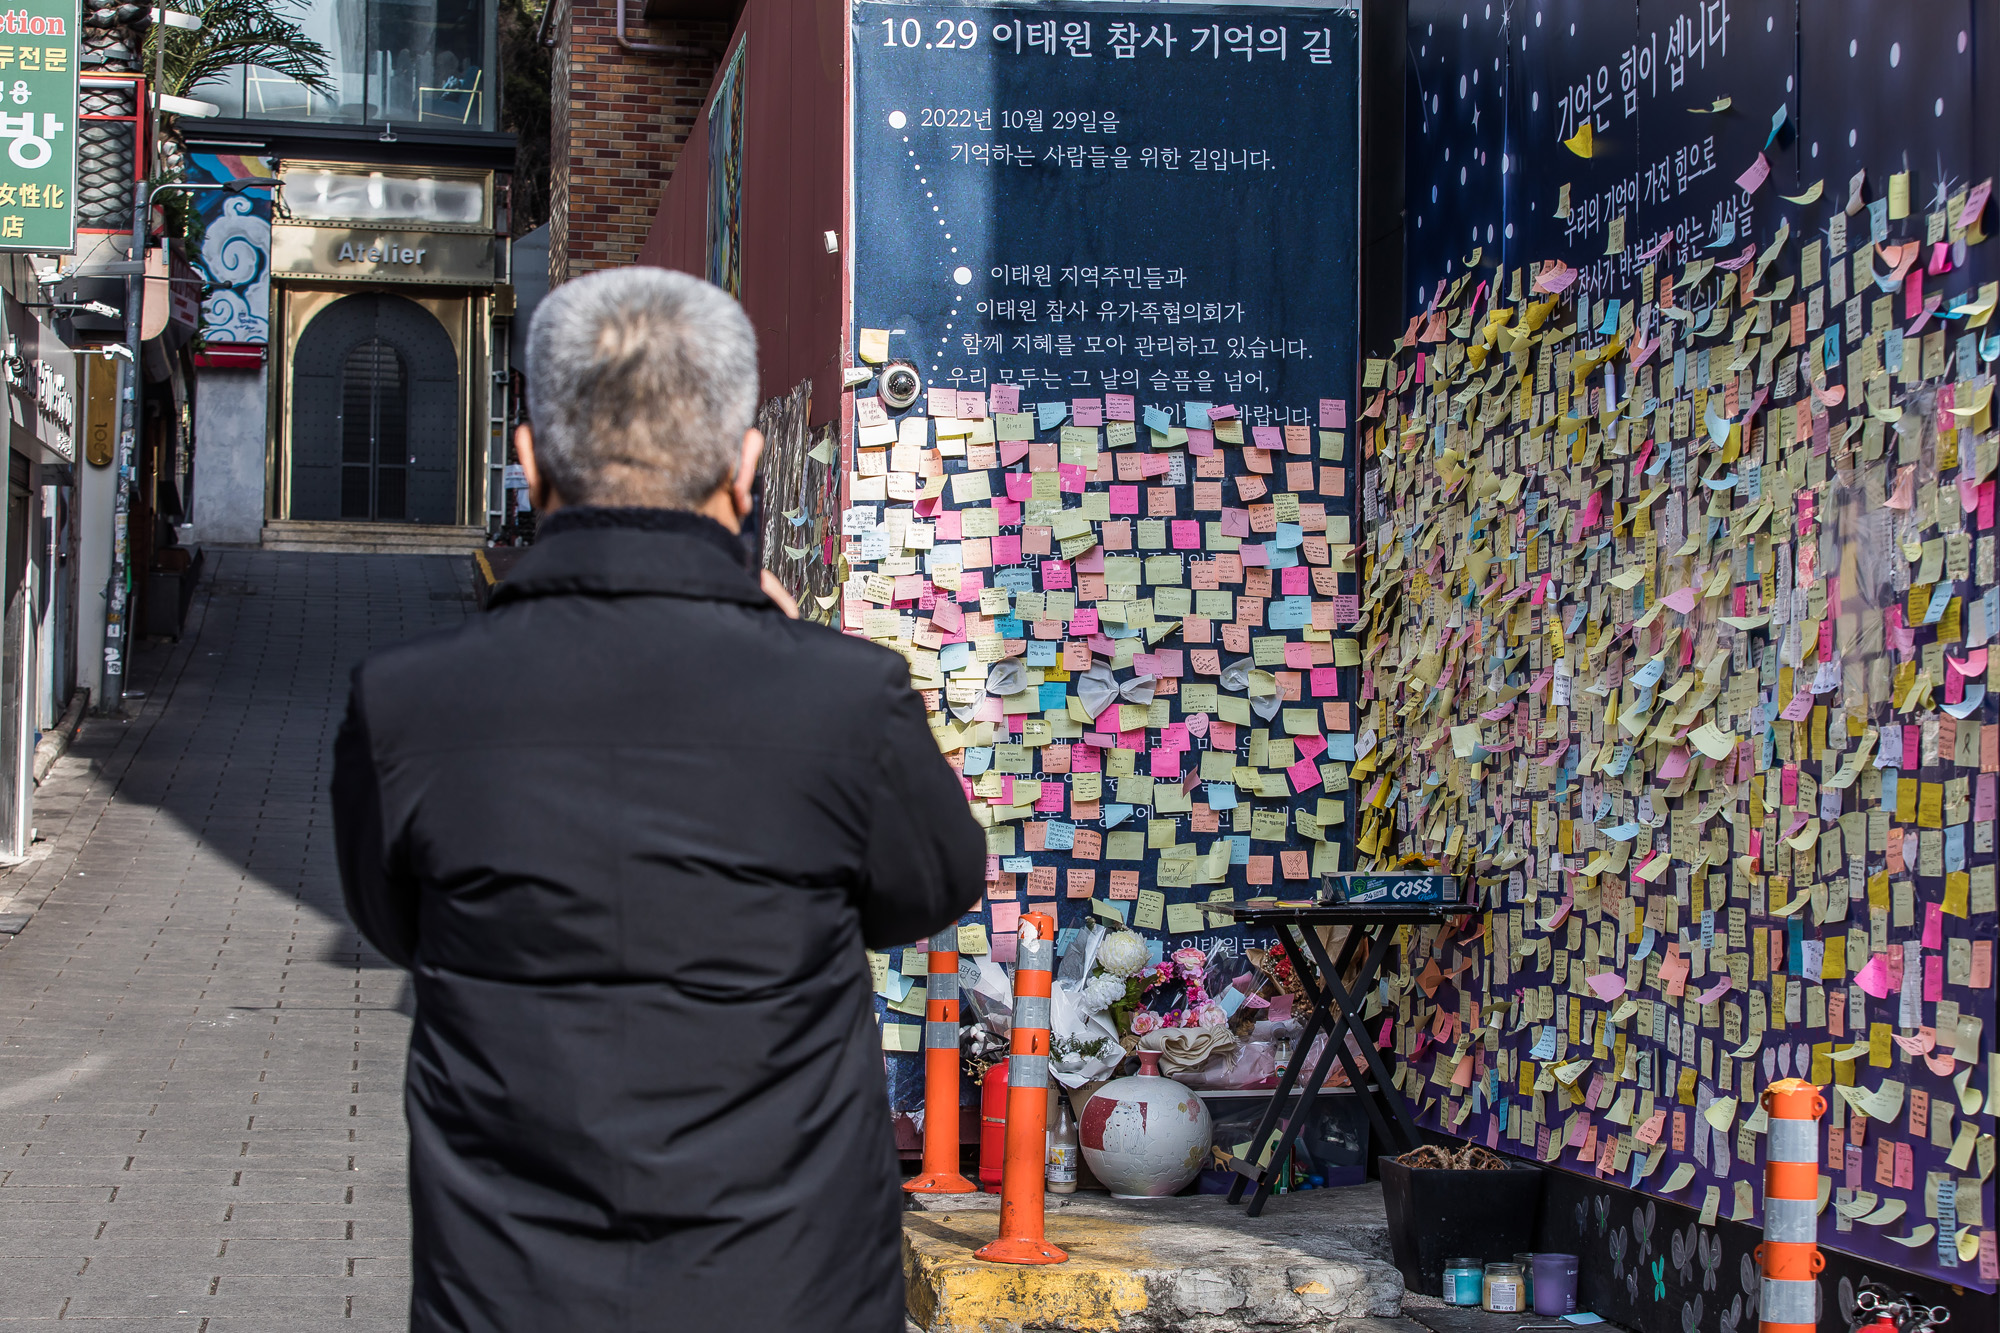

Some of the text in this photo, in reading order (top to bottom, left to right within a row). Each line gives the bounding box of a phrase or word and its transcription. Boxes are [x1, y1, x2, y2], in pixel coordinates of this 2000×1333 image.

[881, 18, 1333, 64] 10.29 이태원 참사 기억의 길
[1619, 32, 1656, 118] 힘이
[1664, 0, 1730, 92] 셉니다
[920, 108, 1120, 134] 2022년 10월 29일을
[0, 111, 64, 170] 방
[950, 142, 1275, 171] 기억하는 사람들을 위한 길입니다.
[1565, 199, 1599, 247] 우리의
[1644, 155, 1670, 205] 가진
[1674, 135, 1716, 194] 힘으로
[1, 215, 25, 239] 店
[338, 241, 426, 267] Atelier
[1676, 217, 1705, 265] 않는
[991, 264, 1187, 290] 이태원 지역주민들과
[975, 298, 1245, 325] 이태원 참사 유가족협의회가
[960, 333, 1313, 359] 함께 지혜를 모아 관리하고 있습니다.
[946, 367, 1269, 393] 우리 모두는 그 날의 슬픔을 넘어,
[1417, 893, 1438, 902] Fresh
